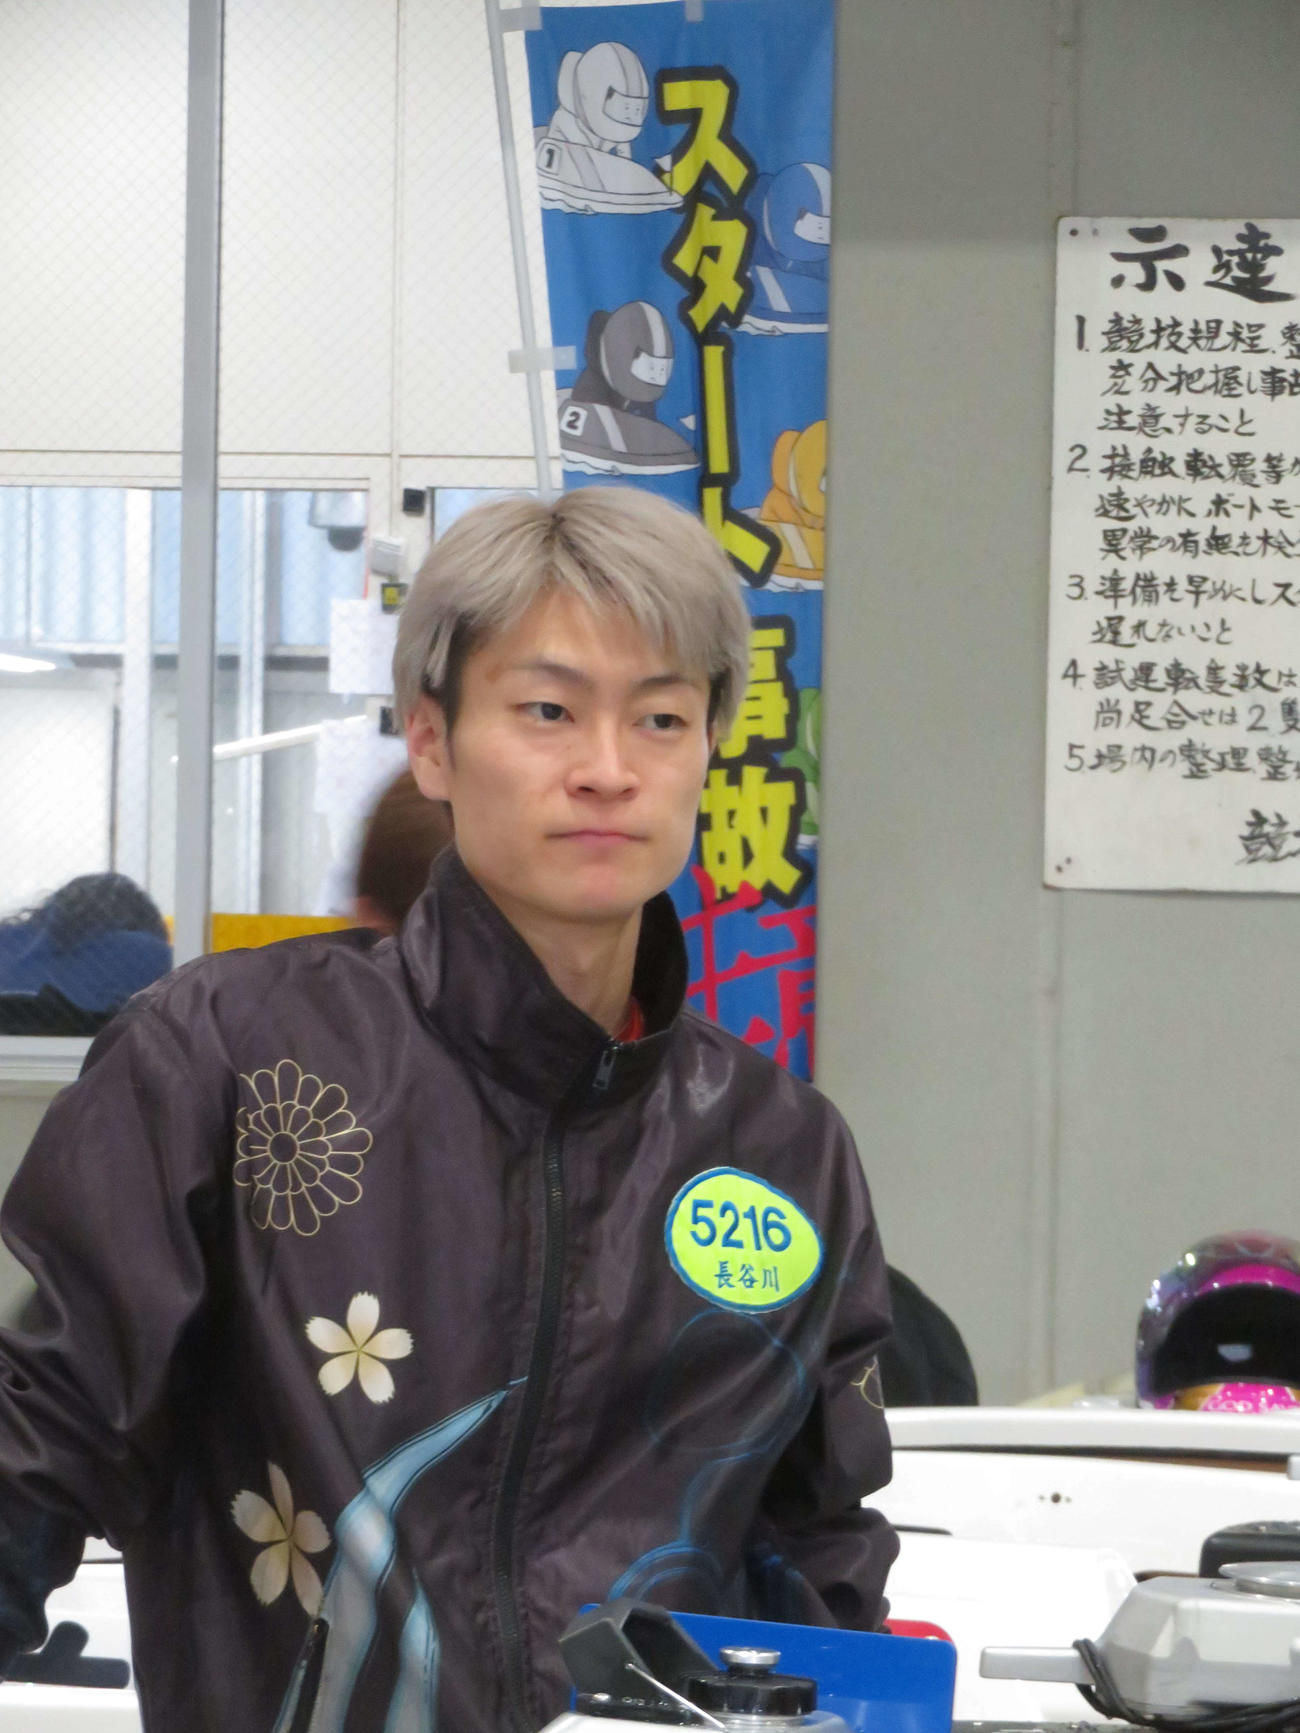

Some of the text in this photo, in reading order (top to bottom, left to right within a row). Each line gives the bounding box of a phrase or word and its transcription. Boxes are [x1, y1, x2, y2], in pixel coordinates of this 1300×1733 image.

[543, 148, 555, 170] 1
[566, 411, 581, 431] 2
[1096, 403, 1257, 438] 注意すること
[1099, 524, 1300, 562] 異常の有無を検
[1094, 568, 1300, 610] 準備を早めにしス
[1091, 615, 1234, 648] 遅れないこと
[1089, 738, 1300, 782] 場内の整理、整
[689, 1198, 792, 1253] 5216
[713, 1260, 781, 1293] 長谷川
